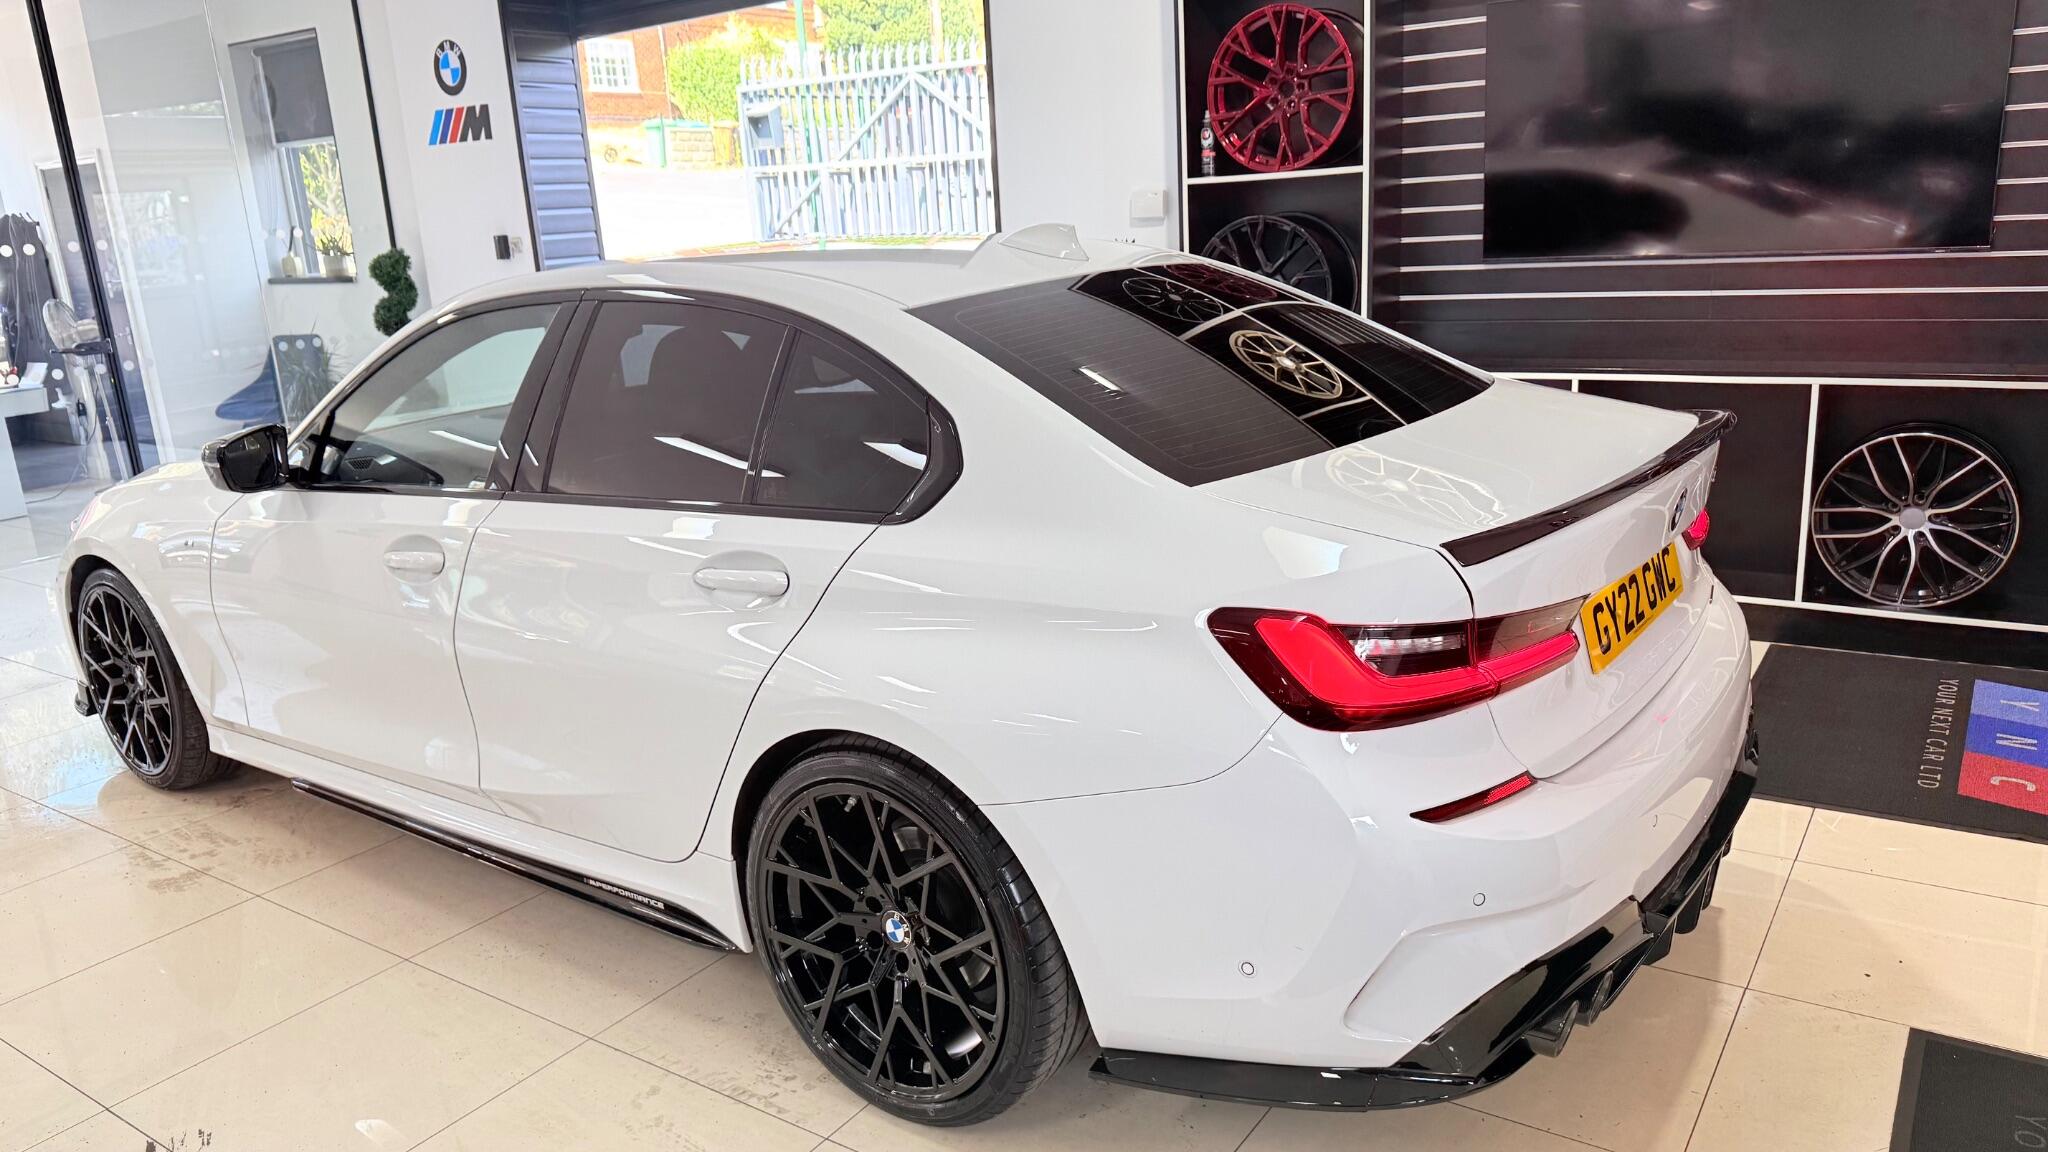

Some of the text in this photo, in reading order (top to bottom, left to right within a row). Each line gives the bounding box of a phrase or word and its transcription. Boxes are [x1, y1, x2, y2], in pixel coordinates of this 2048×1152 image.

[435, 41, 461, 57] BMW
[1592, 546, 1676, 655] GY22 GWC
[1917, 679, 1960, 789] YOUR NEXT CAR LTD
